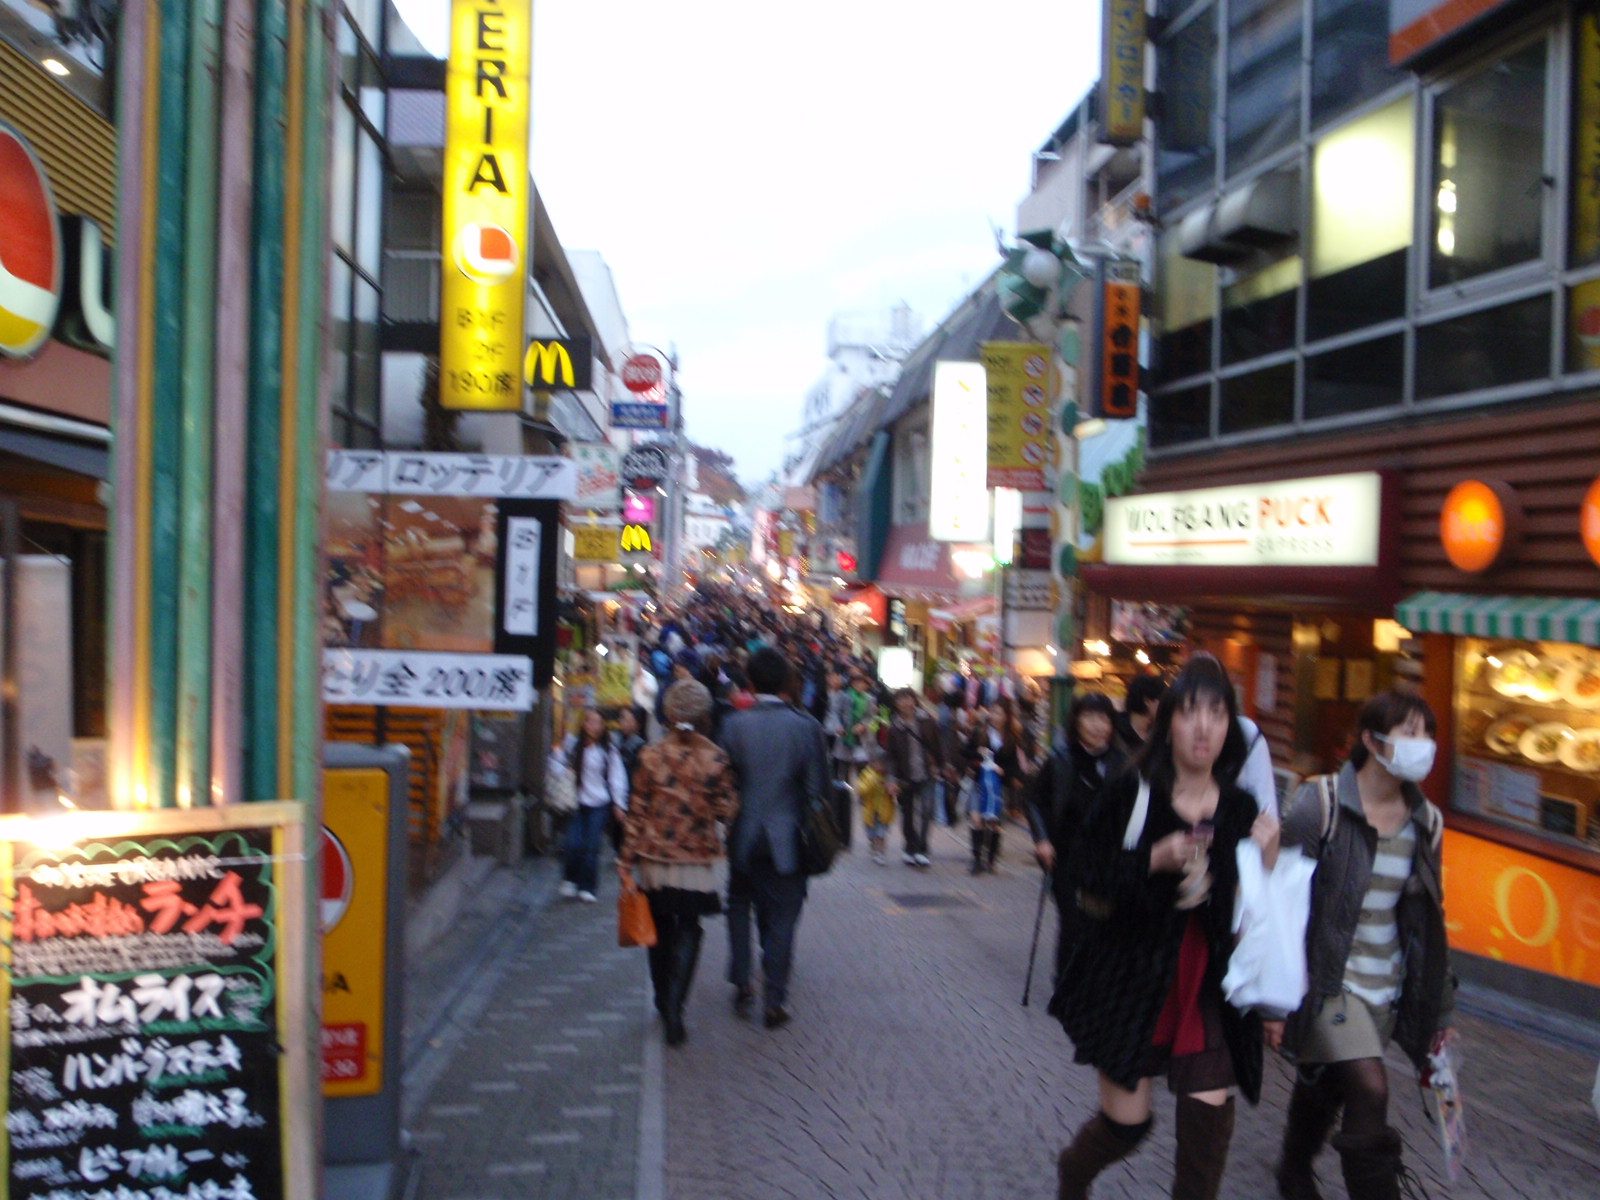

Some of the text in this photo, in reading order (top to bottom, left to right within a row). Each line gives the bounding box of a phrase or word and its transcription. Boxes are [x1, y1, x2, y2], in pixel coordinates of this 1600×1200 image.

[468, 0, 508, 194] ERIA
[395, 455, 565, 496] ロッテリア
[1126, 496, 1332, 533] WOLFGANG PUCK
[61, 974, 225, 1027] オムライス
